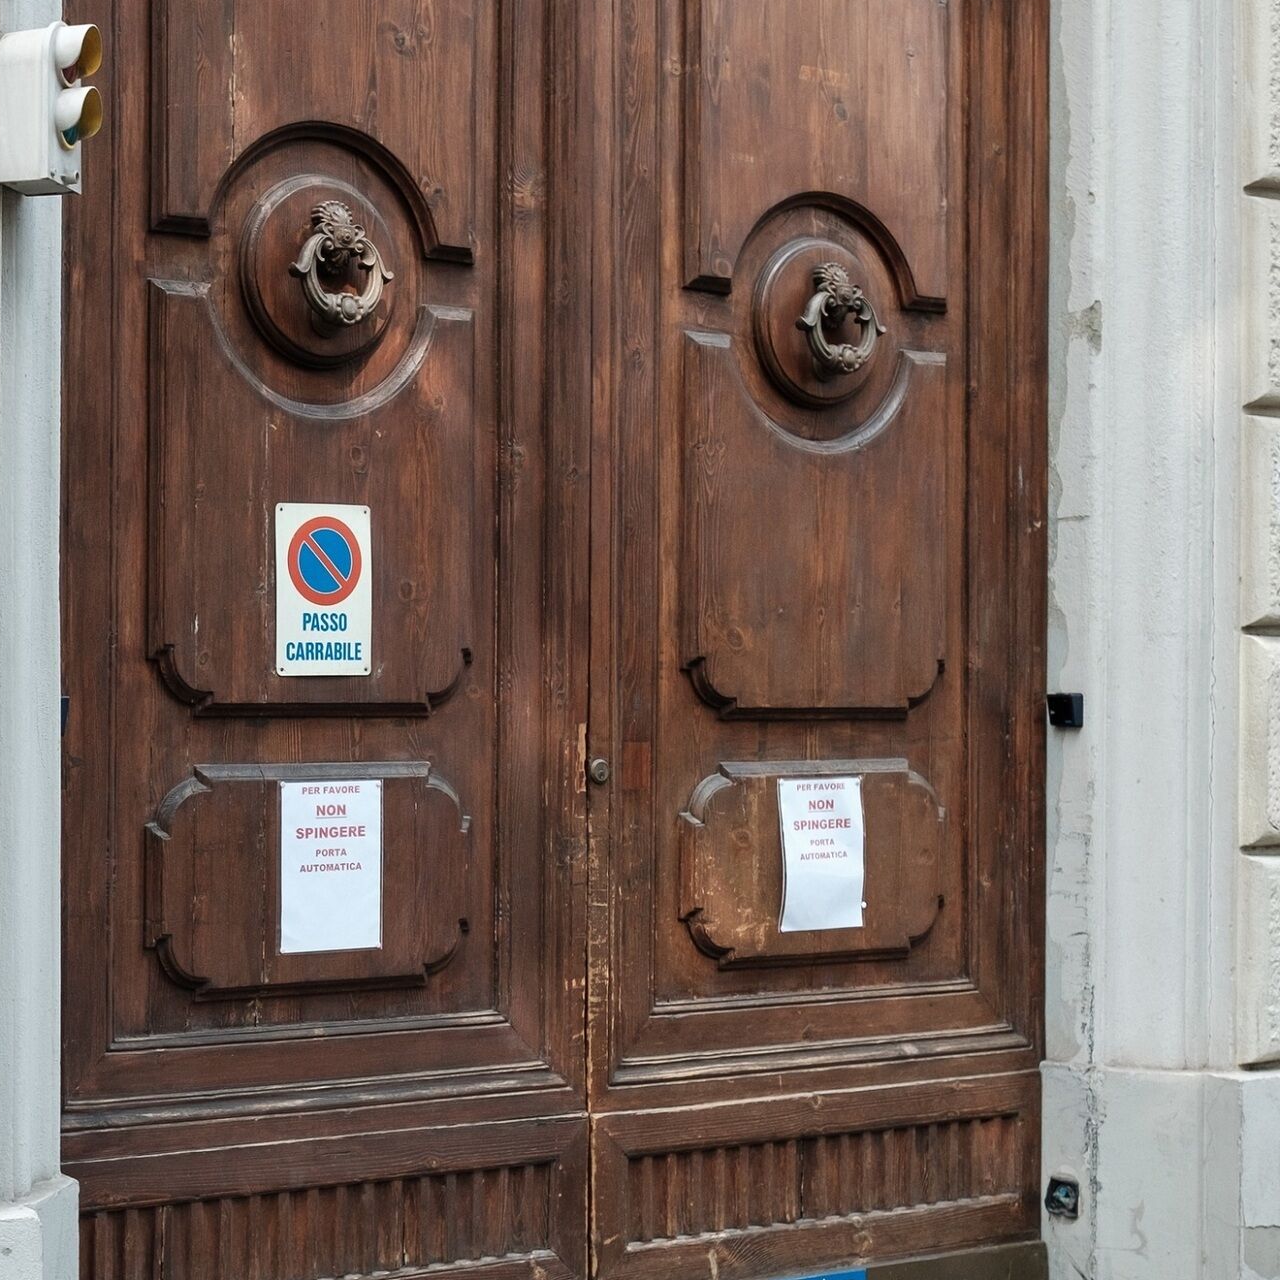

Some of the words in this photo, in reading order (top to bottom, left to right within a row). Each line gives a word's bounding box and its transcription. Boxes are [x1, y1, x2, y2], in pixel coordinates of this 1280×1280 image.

[302, 612, 347, 632] PASSO
[286, 642, 362, 661] CARRABILE
[302, 786, 320, 795] PER
[323, 785, 360, 794] FAVORE
[814, 783, 845, 791] FAVORE
[316, 804, 346, 816] NON
[808, 799, 834, 810] NON
[793, 818, 852, 831] SPINGERE
[296, 825, 366, 839] SPINGERE
[315, 848, 347, 857] PORTA
[800, 851, 848, 861] AUTOMATICA
[299, 862, 362, 873] AUTOMATICA
